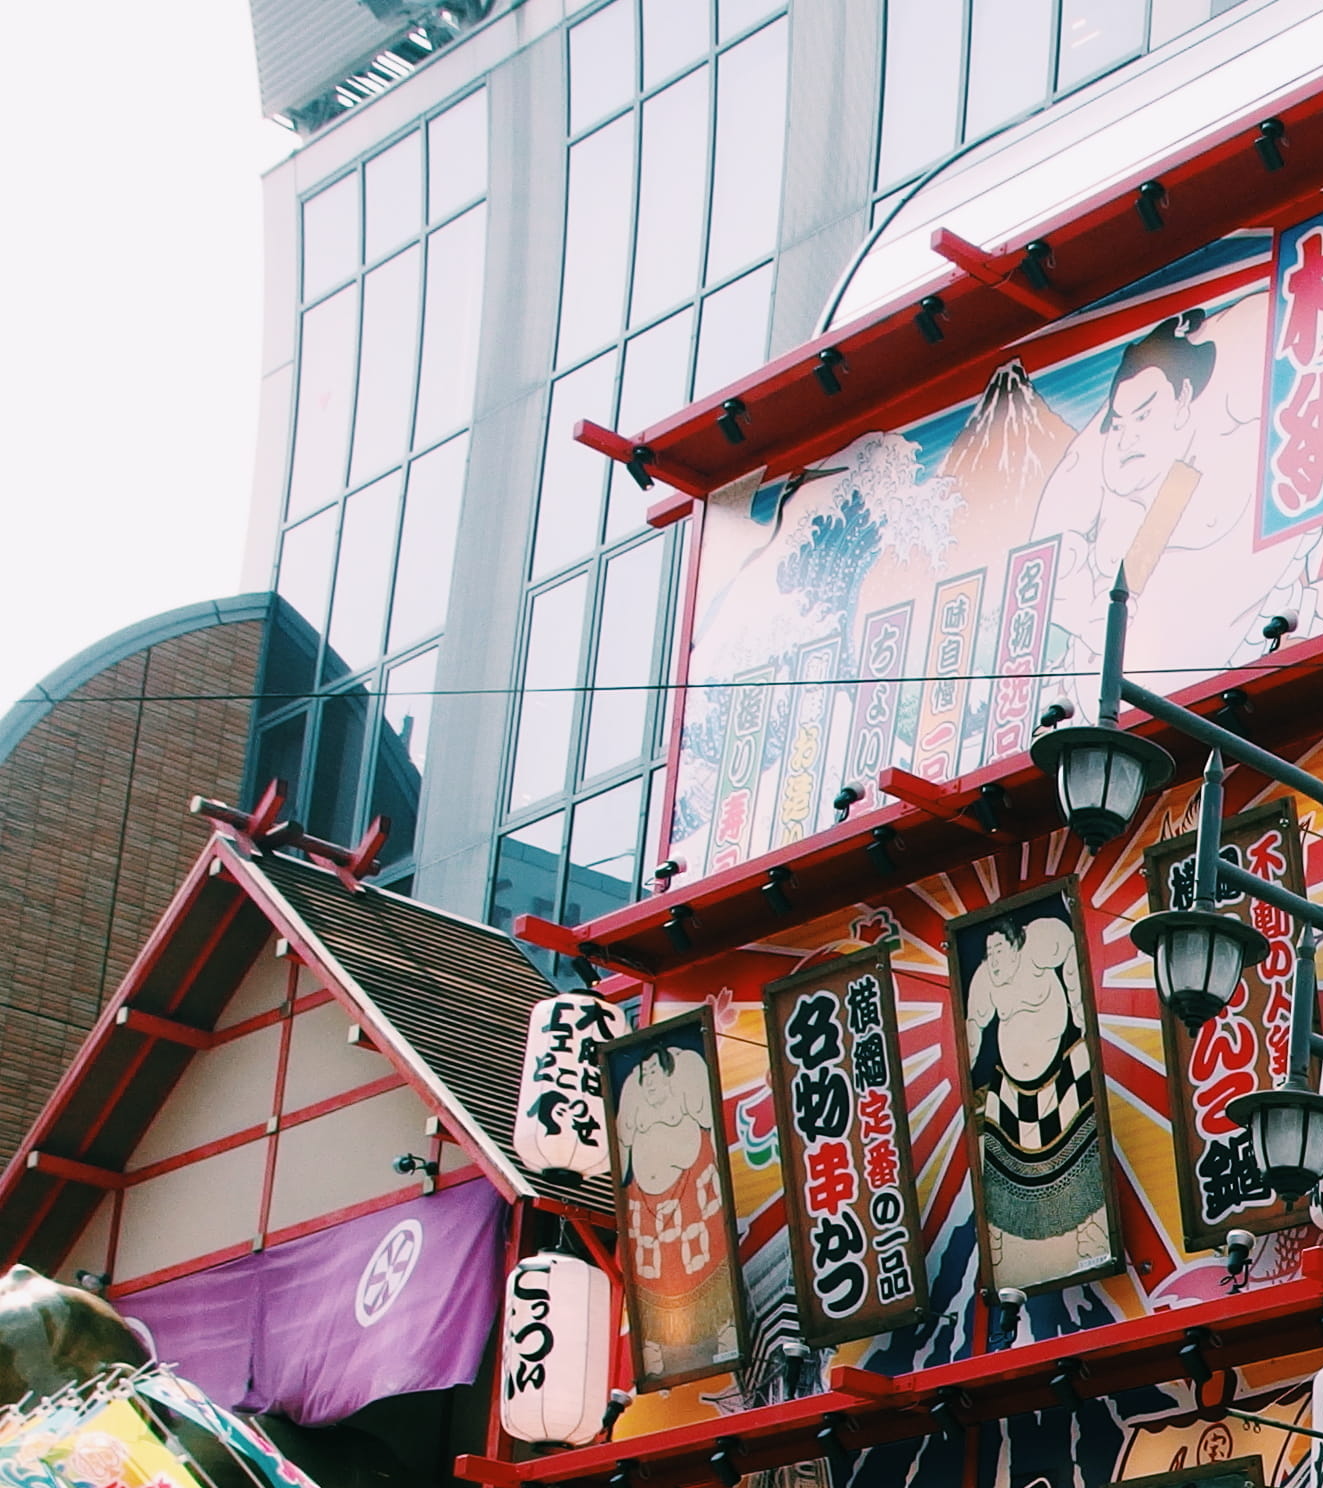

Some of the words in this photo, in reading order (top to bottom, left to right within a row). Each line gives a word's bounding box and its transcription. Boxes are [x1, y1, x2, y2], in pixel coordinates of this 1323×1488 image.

[790, 991, 868, 1319] 名物串かつ
[847, 975, 912, 1305] 横綱定番の一品
